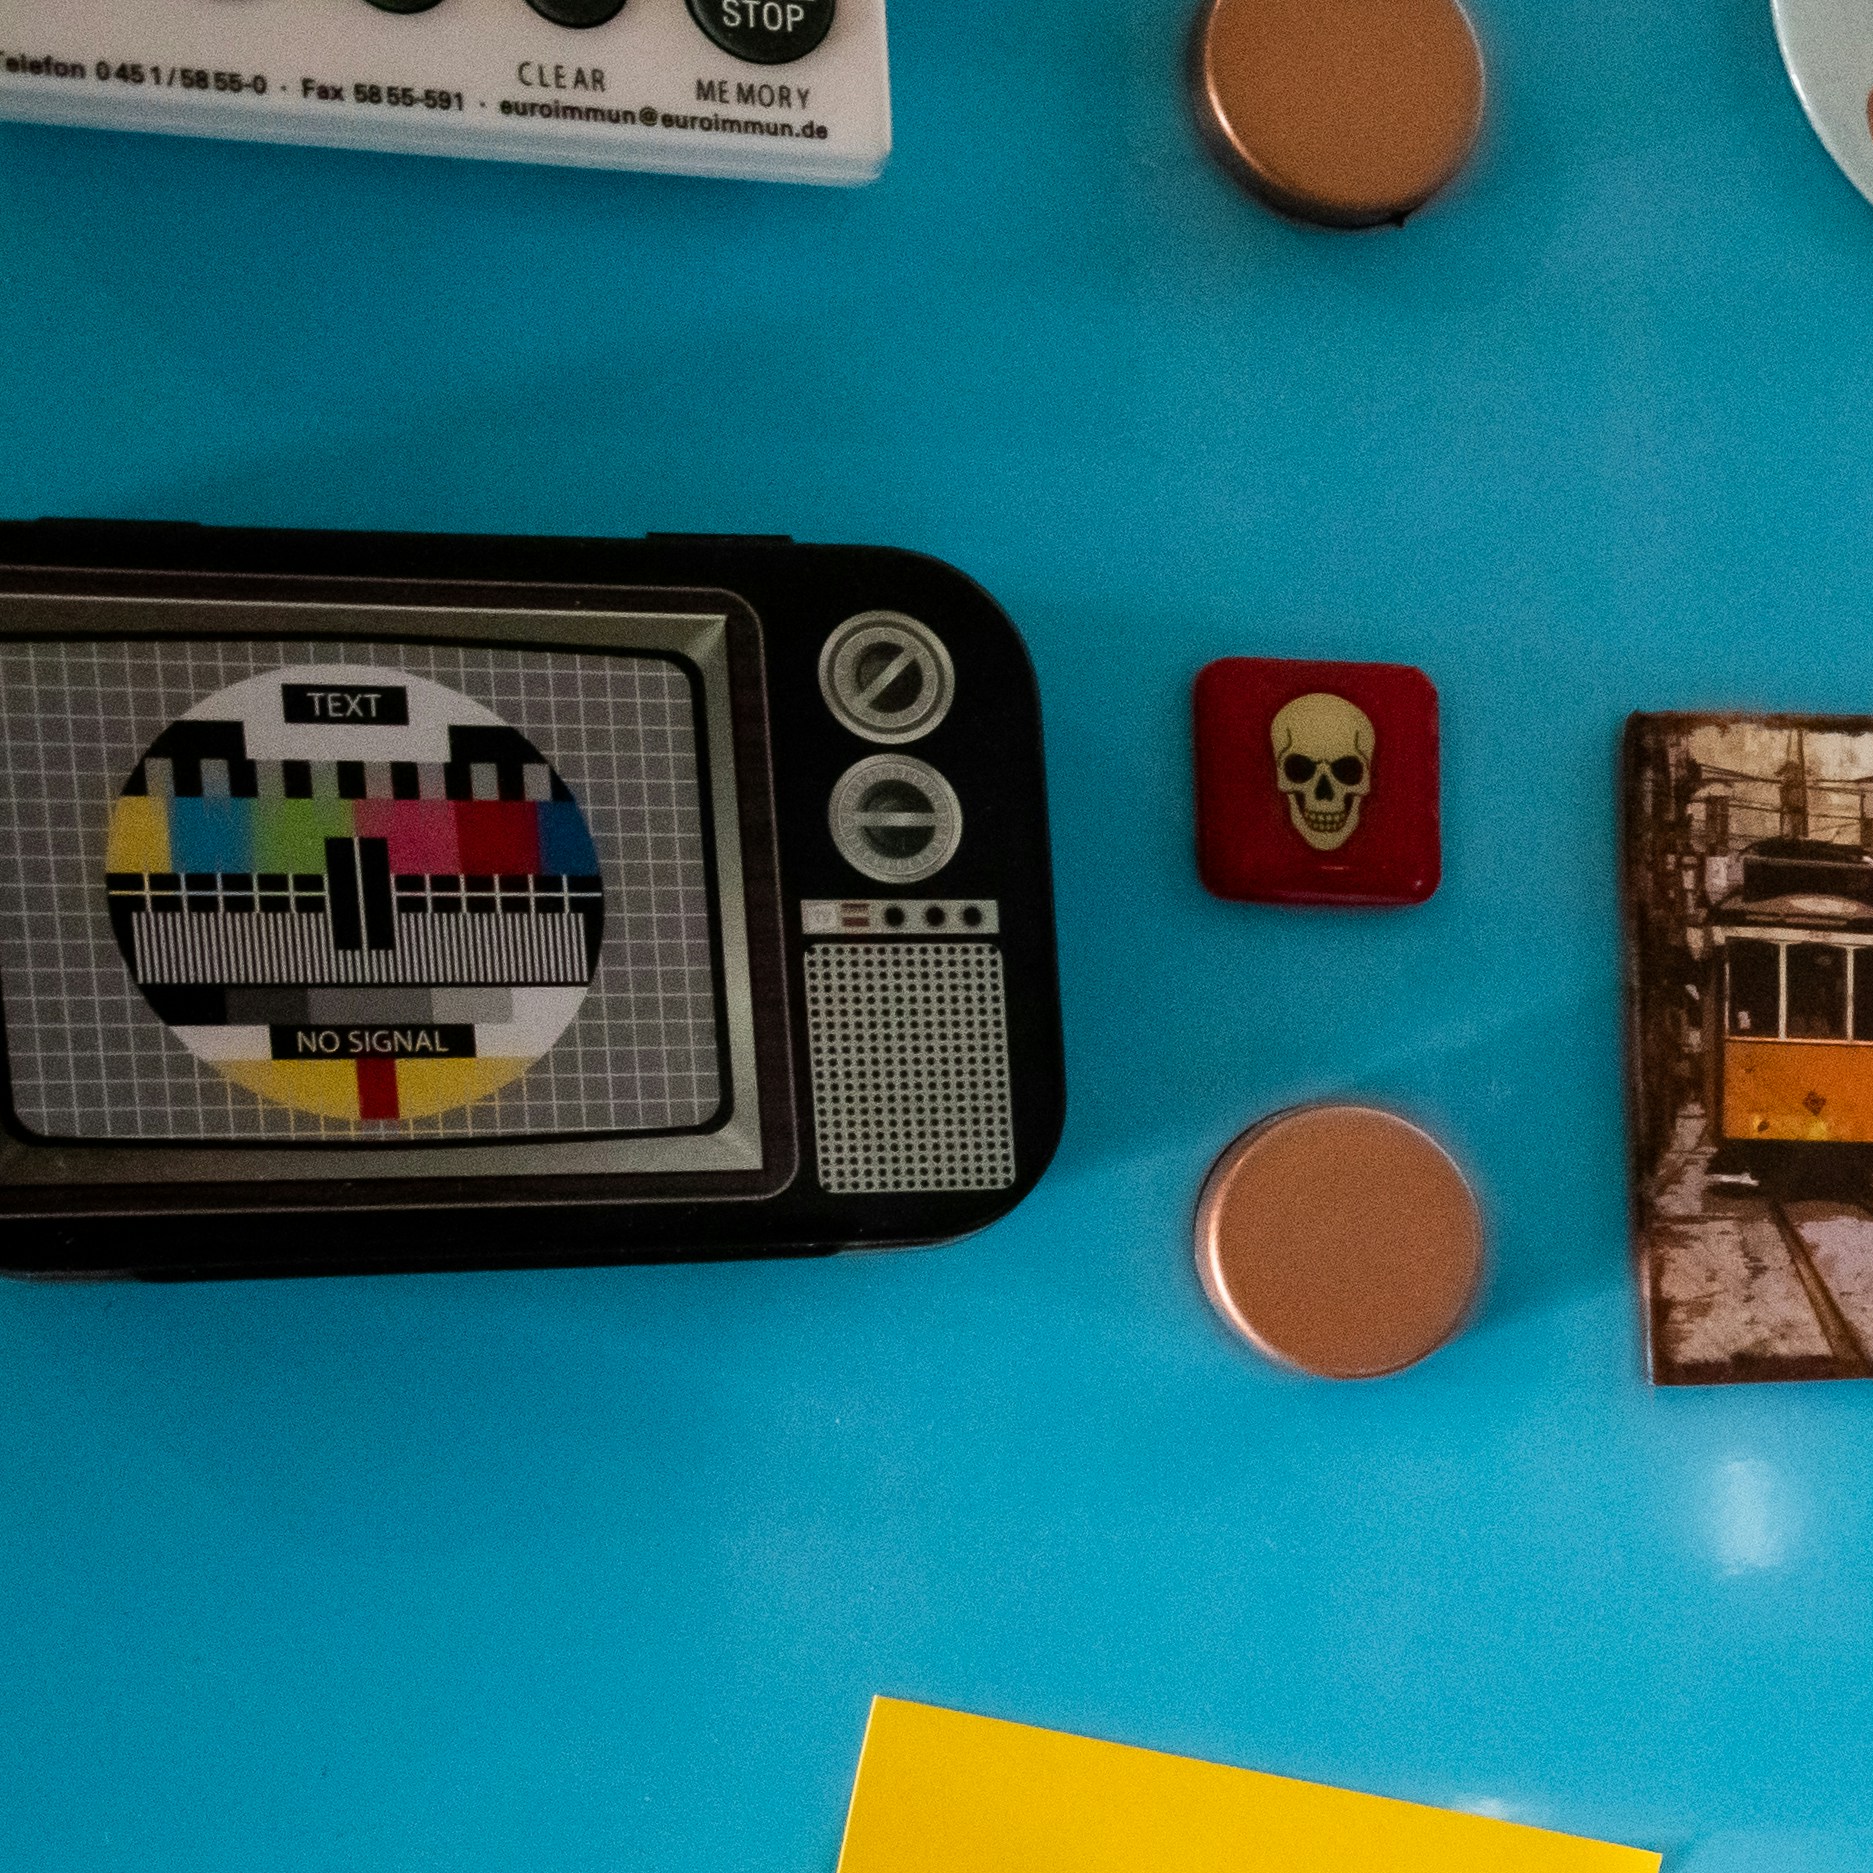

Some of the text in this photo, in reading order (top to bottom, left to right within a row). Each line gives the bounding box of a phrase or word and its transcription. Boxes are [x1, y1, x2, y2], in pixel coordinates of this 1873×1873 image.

[722, 0, 804, 32] STOP
[517, 61, 606, 93] CLEAR
[0, 49, 86, 79] elefon
[301, 77, 344, 101] Fax
[500, 98, 829, 140] euroimmun@euroimmun.de
[695, 78, 810, 110] MEMORY
[306, 692, 382, 718] TEXT
[297, 1029, 449, 1054] NO SIGNAL
